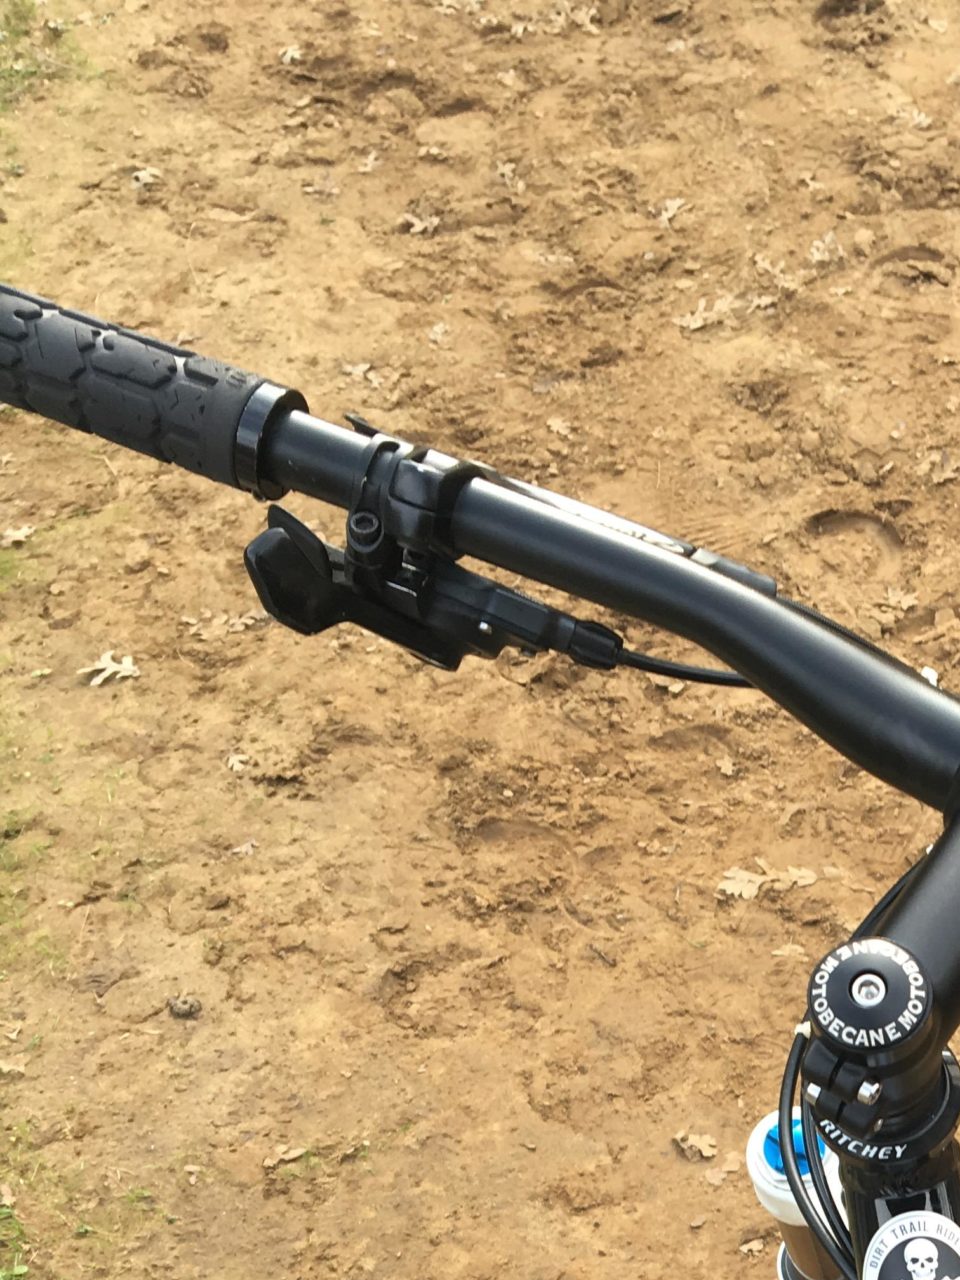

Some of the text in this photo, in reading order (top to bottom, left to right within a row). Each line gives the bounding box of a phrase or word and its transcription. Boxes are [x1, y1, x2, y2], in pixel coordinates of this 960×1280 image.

[812, 957, 901, 1047] MOTOBECANE
[836, 939, 925, 1032] MOTOBNE
[820, 1119, 907, 1159] RITCHEY
[869, 1238, 889, 1269] DIRT
[890, 1220, 929, 1240] TRAIL
